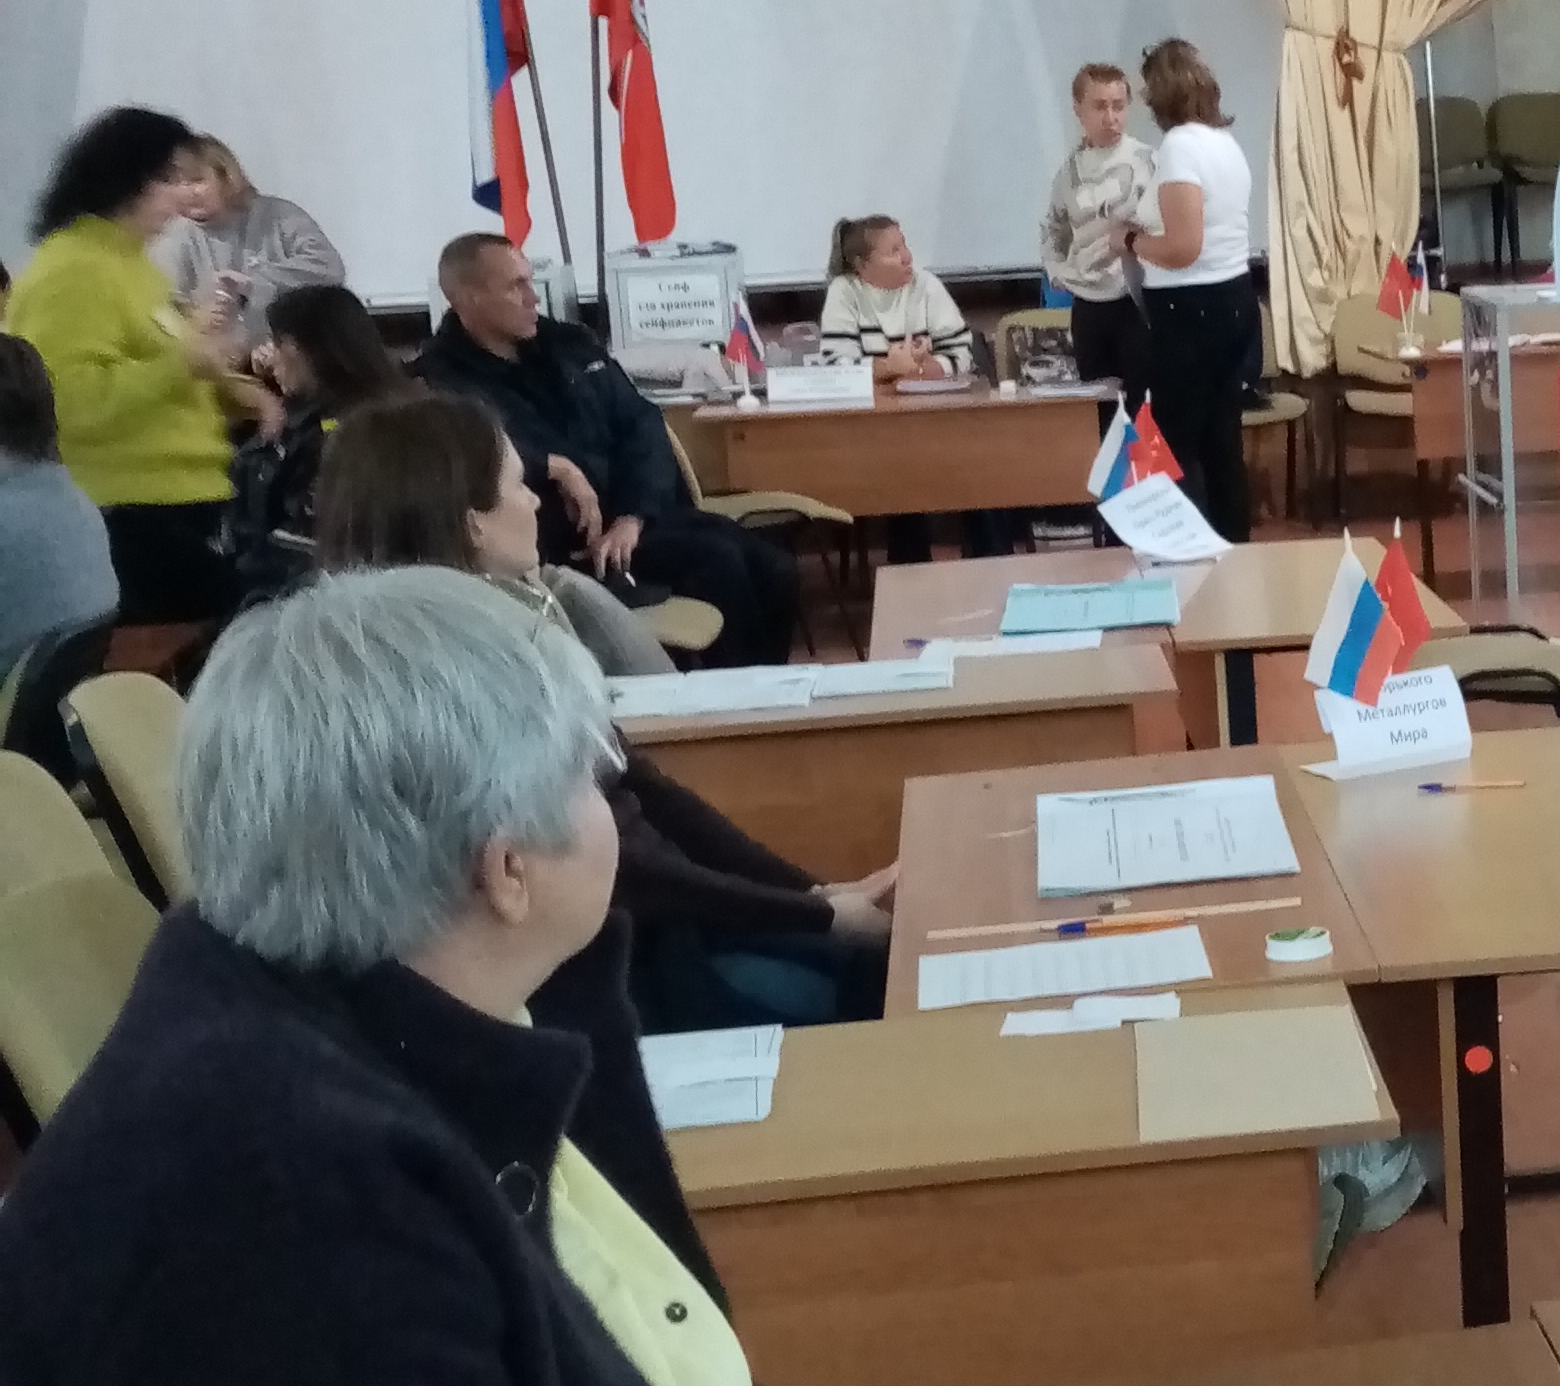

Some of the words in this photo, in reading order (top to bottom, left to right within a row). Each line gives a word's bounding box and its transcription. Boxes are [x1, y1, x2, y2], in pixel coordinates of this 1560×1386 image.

[1384, 674, 1433, 694] рького
[1356, 697, 1448, 723] Металлургов
[1389, 726, 1429, 745] Мира
